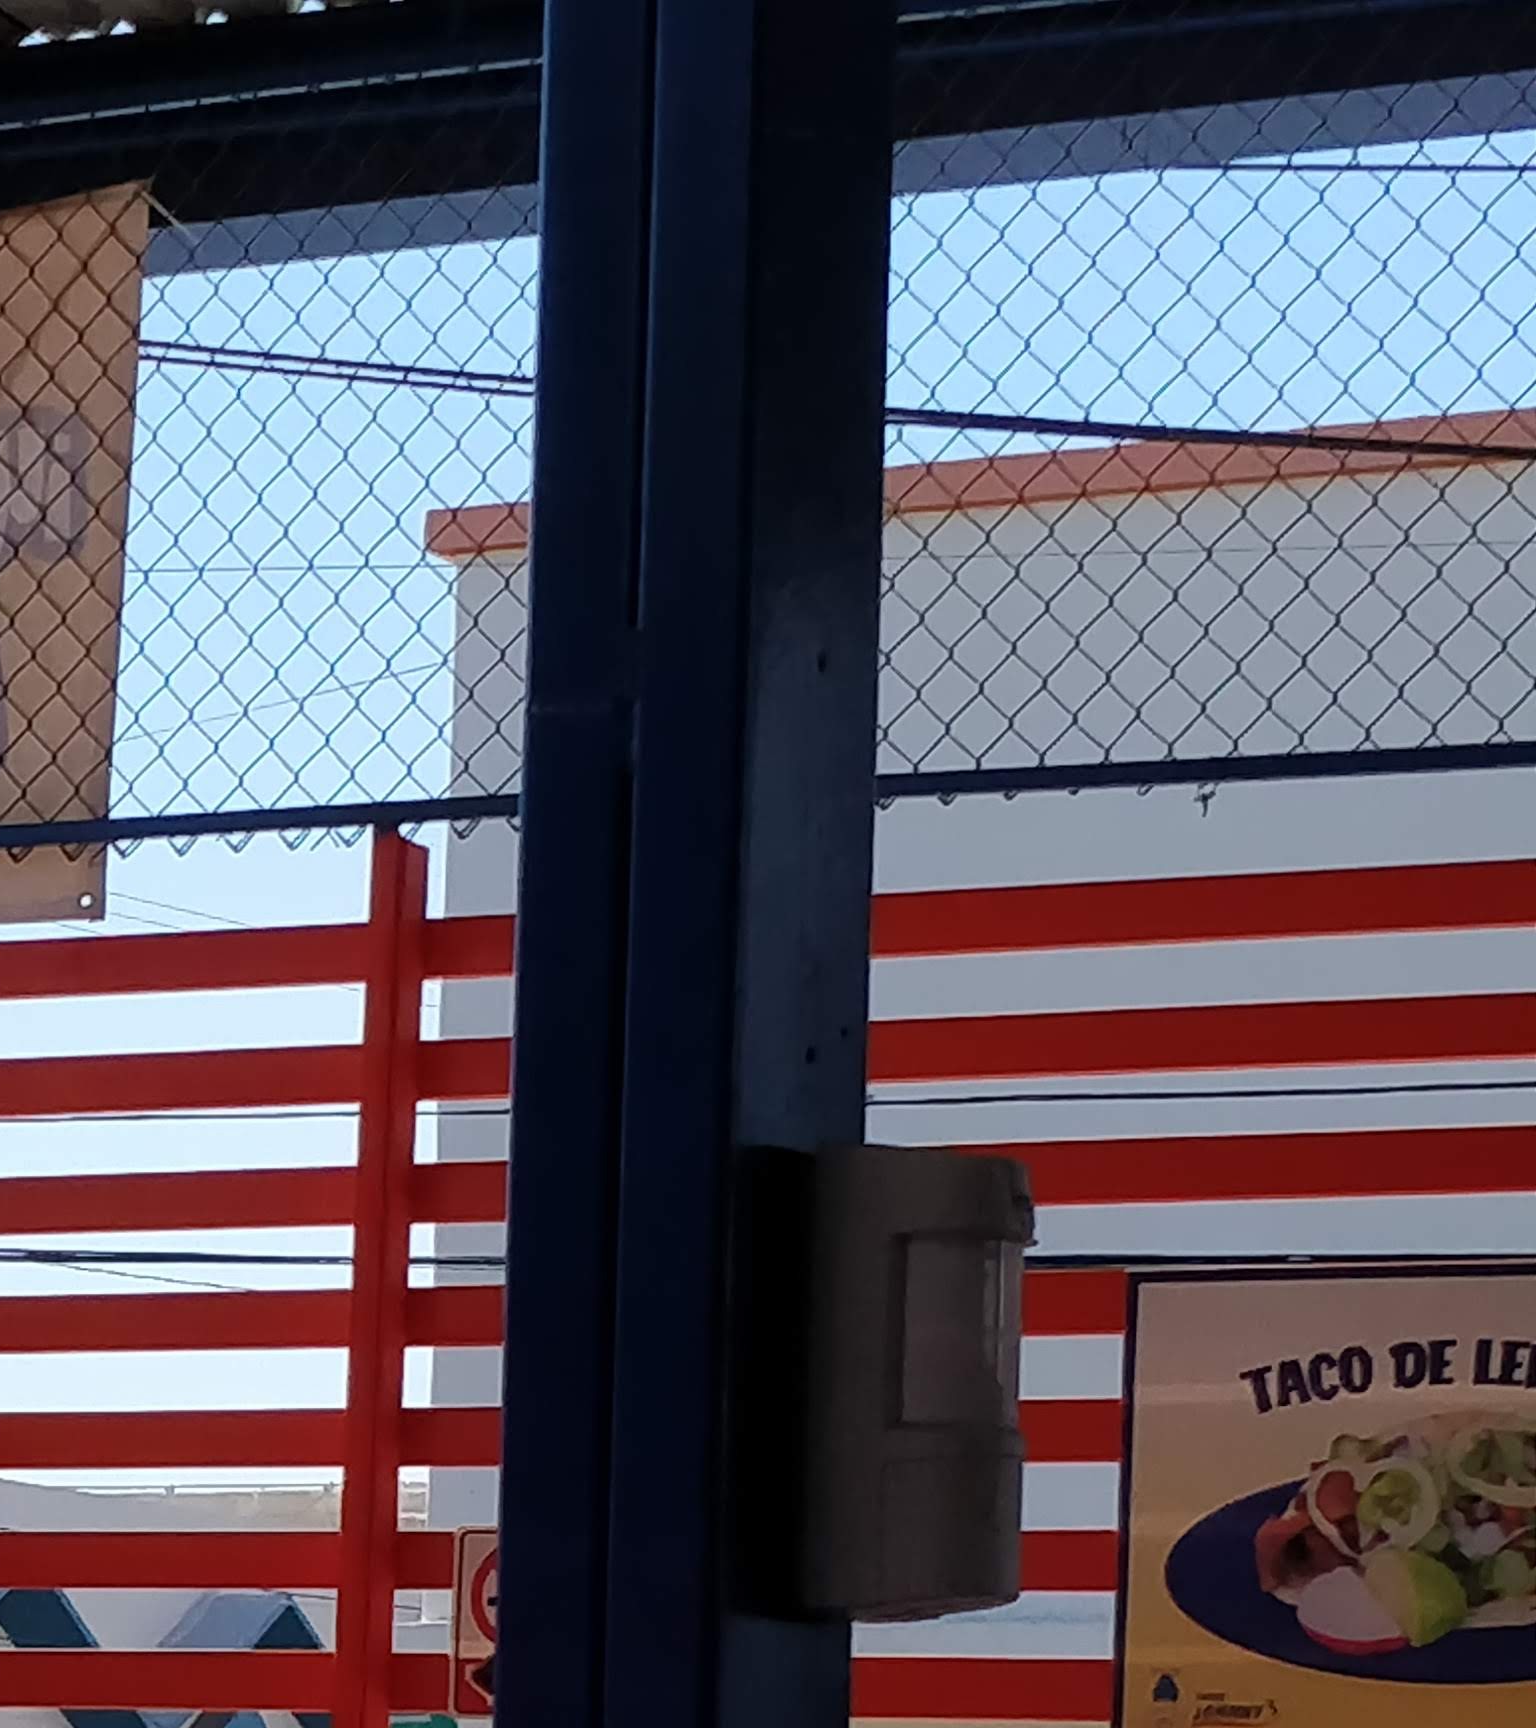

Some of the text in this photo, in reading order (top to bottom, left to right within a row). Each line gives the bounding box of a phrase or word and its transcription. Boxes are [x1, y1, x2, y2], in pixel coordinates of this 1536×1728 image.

[1239, 1338, 1536, 1414] TACO DE LE
